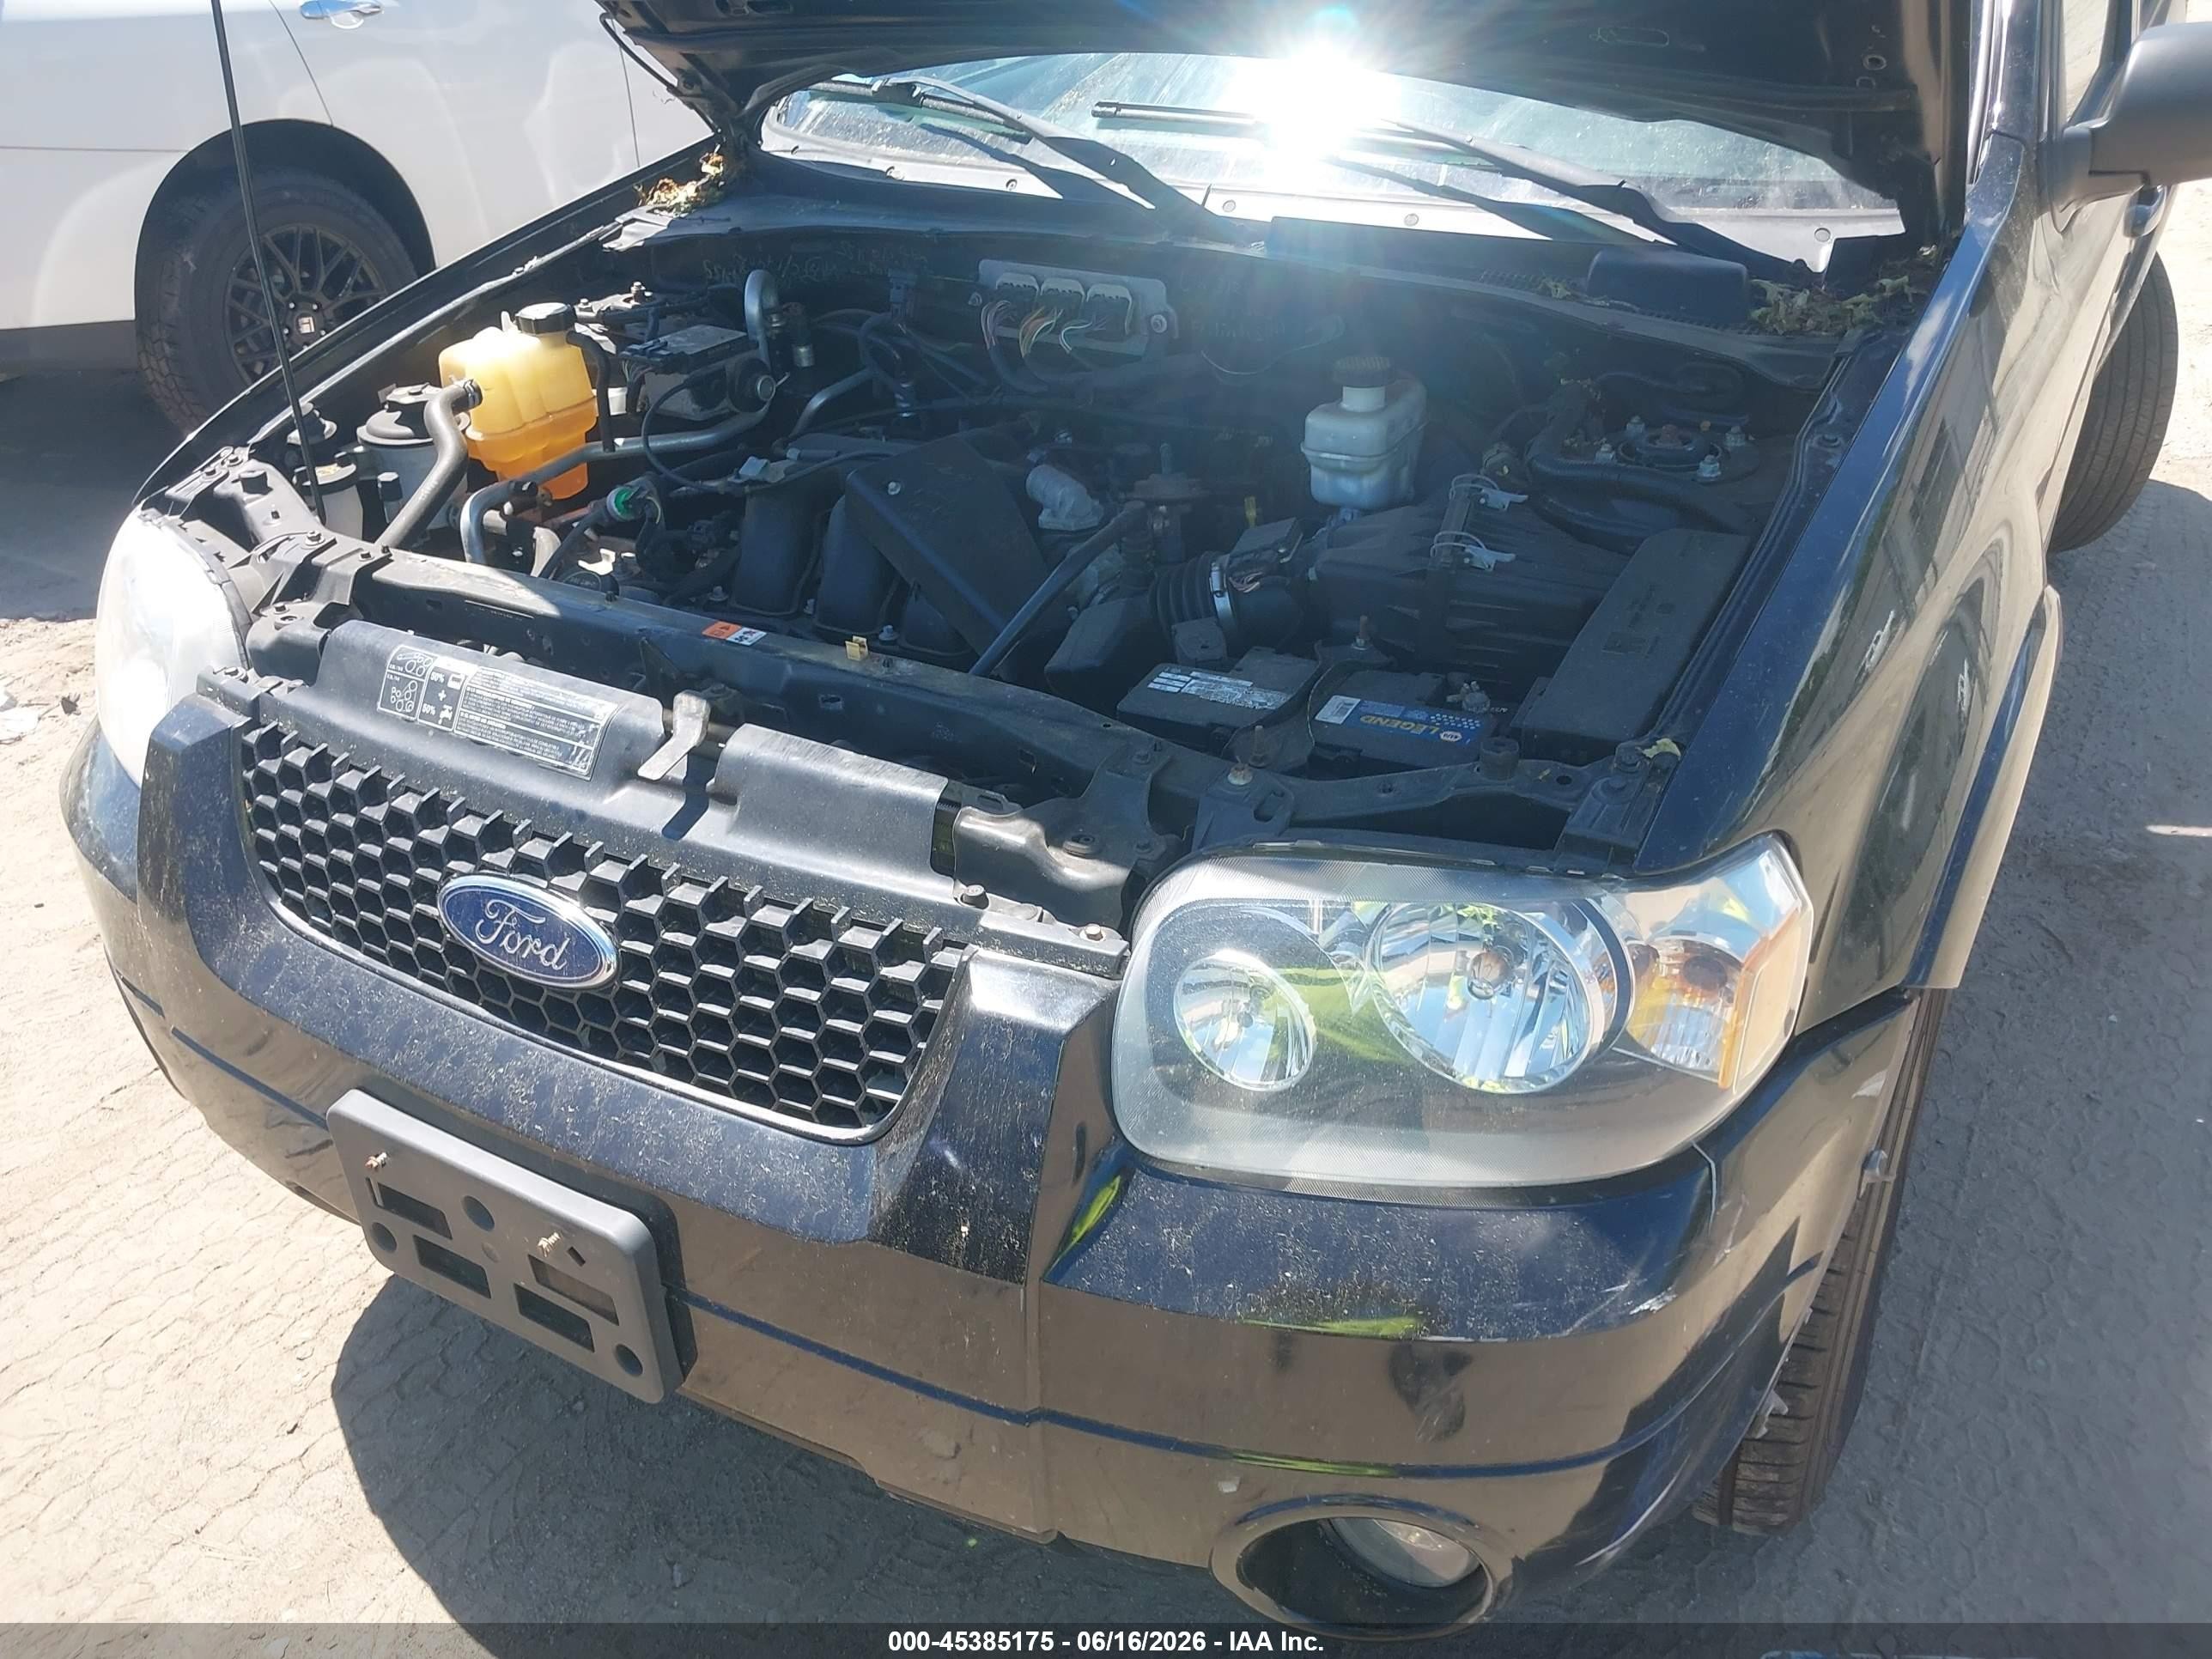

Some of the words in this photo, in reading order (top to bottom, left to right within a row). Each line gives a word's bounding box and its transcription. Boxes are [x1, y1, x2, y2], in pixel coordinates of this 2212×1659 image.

[430, 671, 445, 684] 50%
[422, 703, 436, 716] 50%
[1359, 714, 1440, 735] LEGEND
[475, 899, 569, 970] Ford
